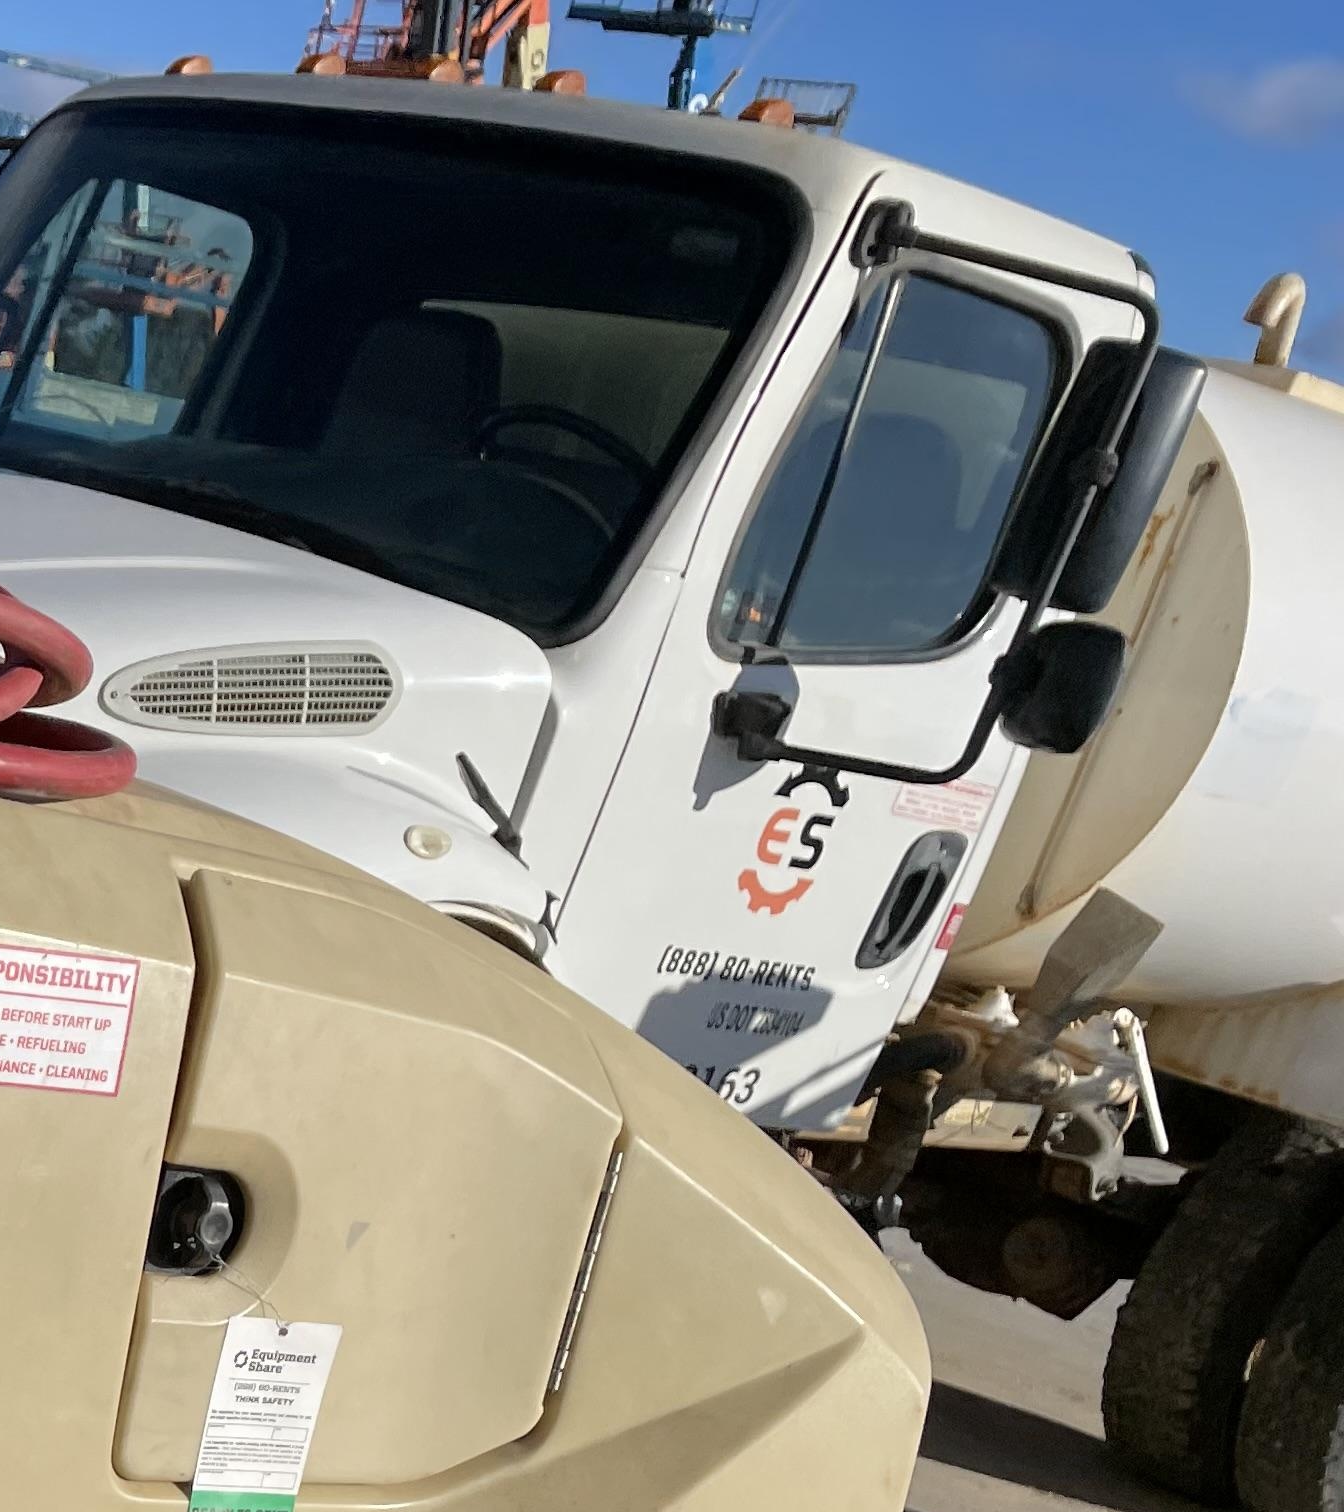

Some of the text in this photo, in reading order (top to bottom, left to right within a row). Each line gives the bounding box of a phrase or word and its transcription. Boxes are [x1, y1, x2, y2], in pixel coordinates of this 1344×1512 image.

[757, 807, 836, 870] ES
[657, 944, 816, 991] (888) 80-RENTS
[0, 1008, 49, 1026] BEFORE
[52, 1014, 93, 1030] START
[94, 1017, 112, 1032] UP
[16, 1035, 87, 1055] REFUELING
[45, 1064, 109, 1083] CLEANING
[252, 1349, 317, 1364] Equipment
[248, 1361, 283, 1374] Share
